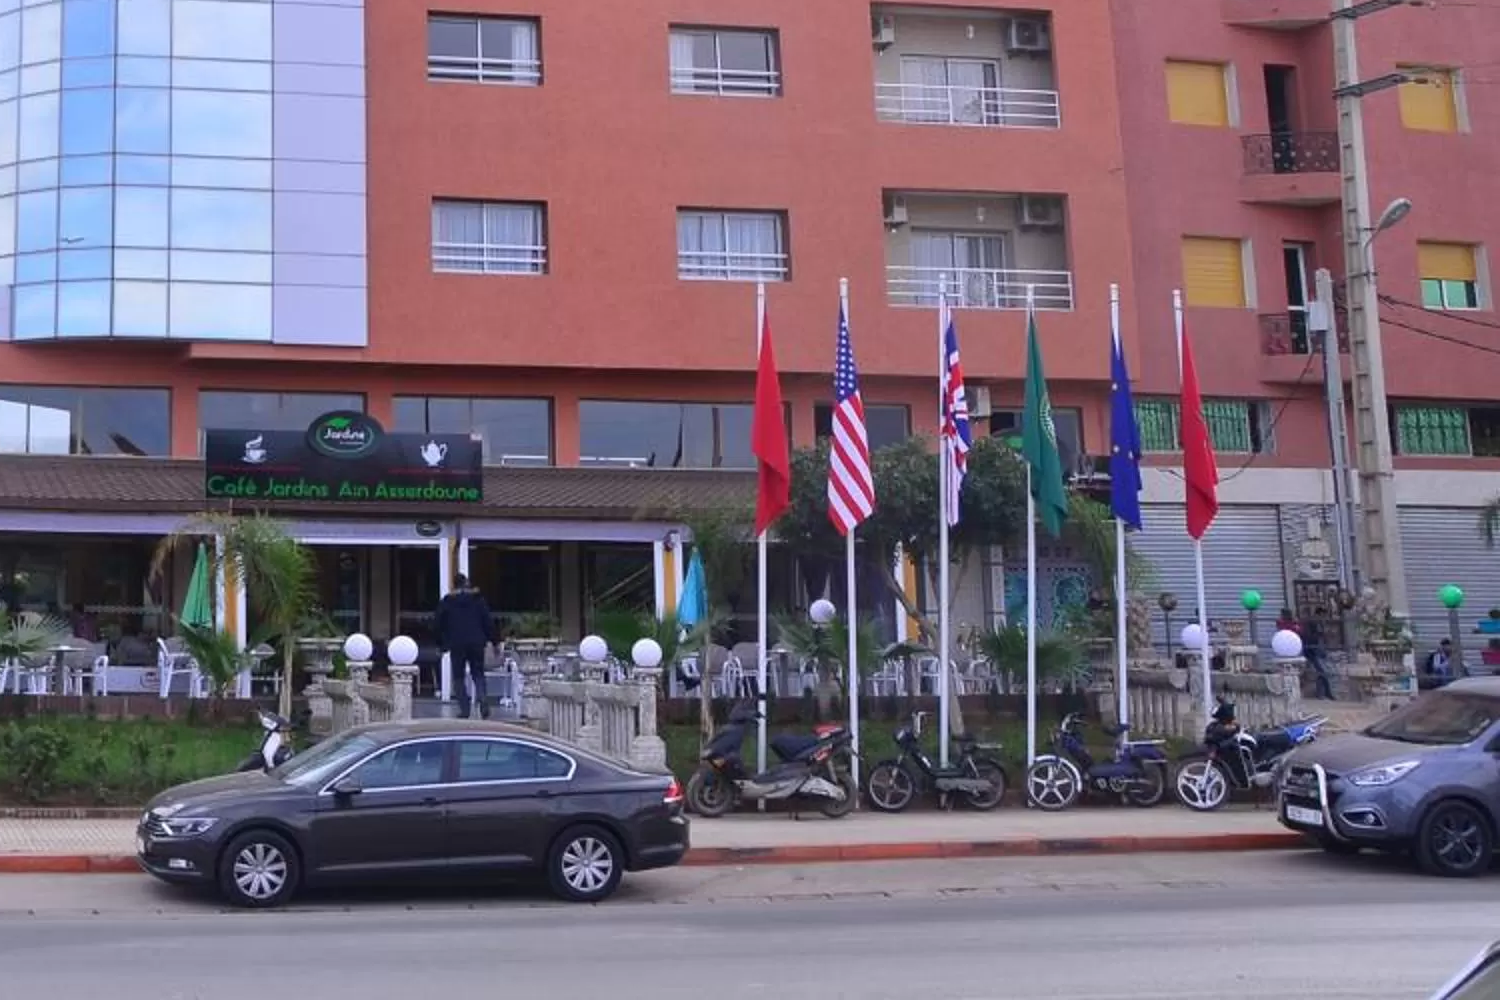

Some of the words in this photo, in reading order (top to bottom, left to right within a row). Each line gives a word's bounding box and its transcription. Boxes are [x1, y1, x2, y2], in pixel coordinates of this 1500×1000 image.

[208, 475, 257, 496] Café
[264, 479, 329, 497] Jardins
[339, 480, 369, 498] Ain
